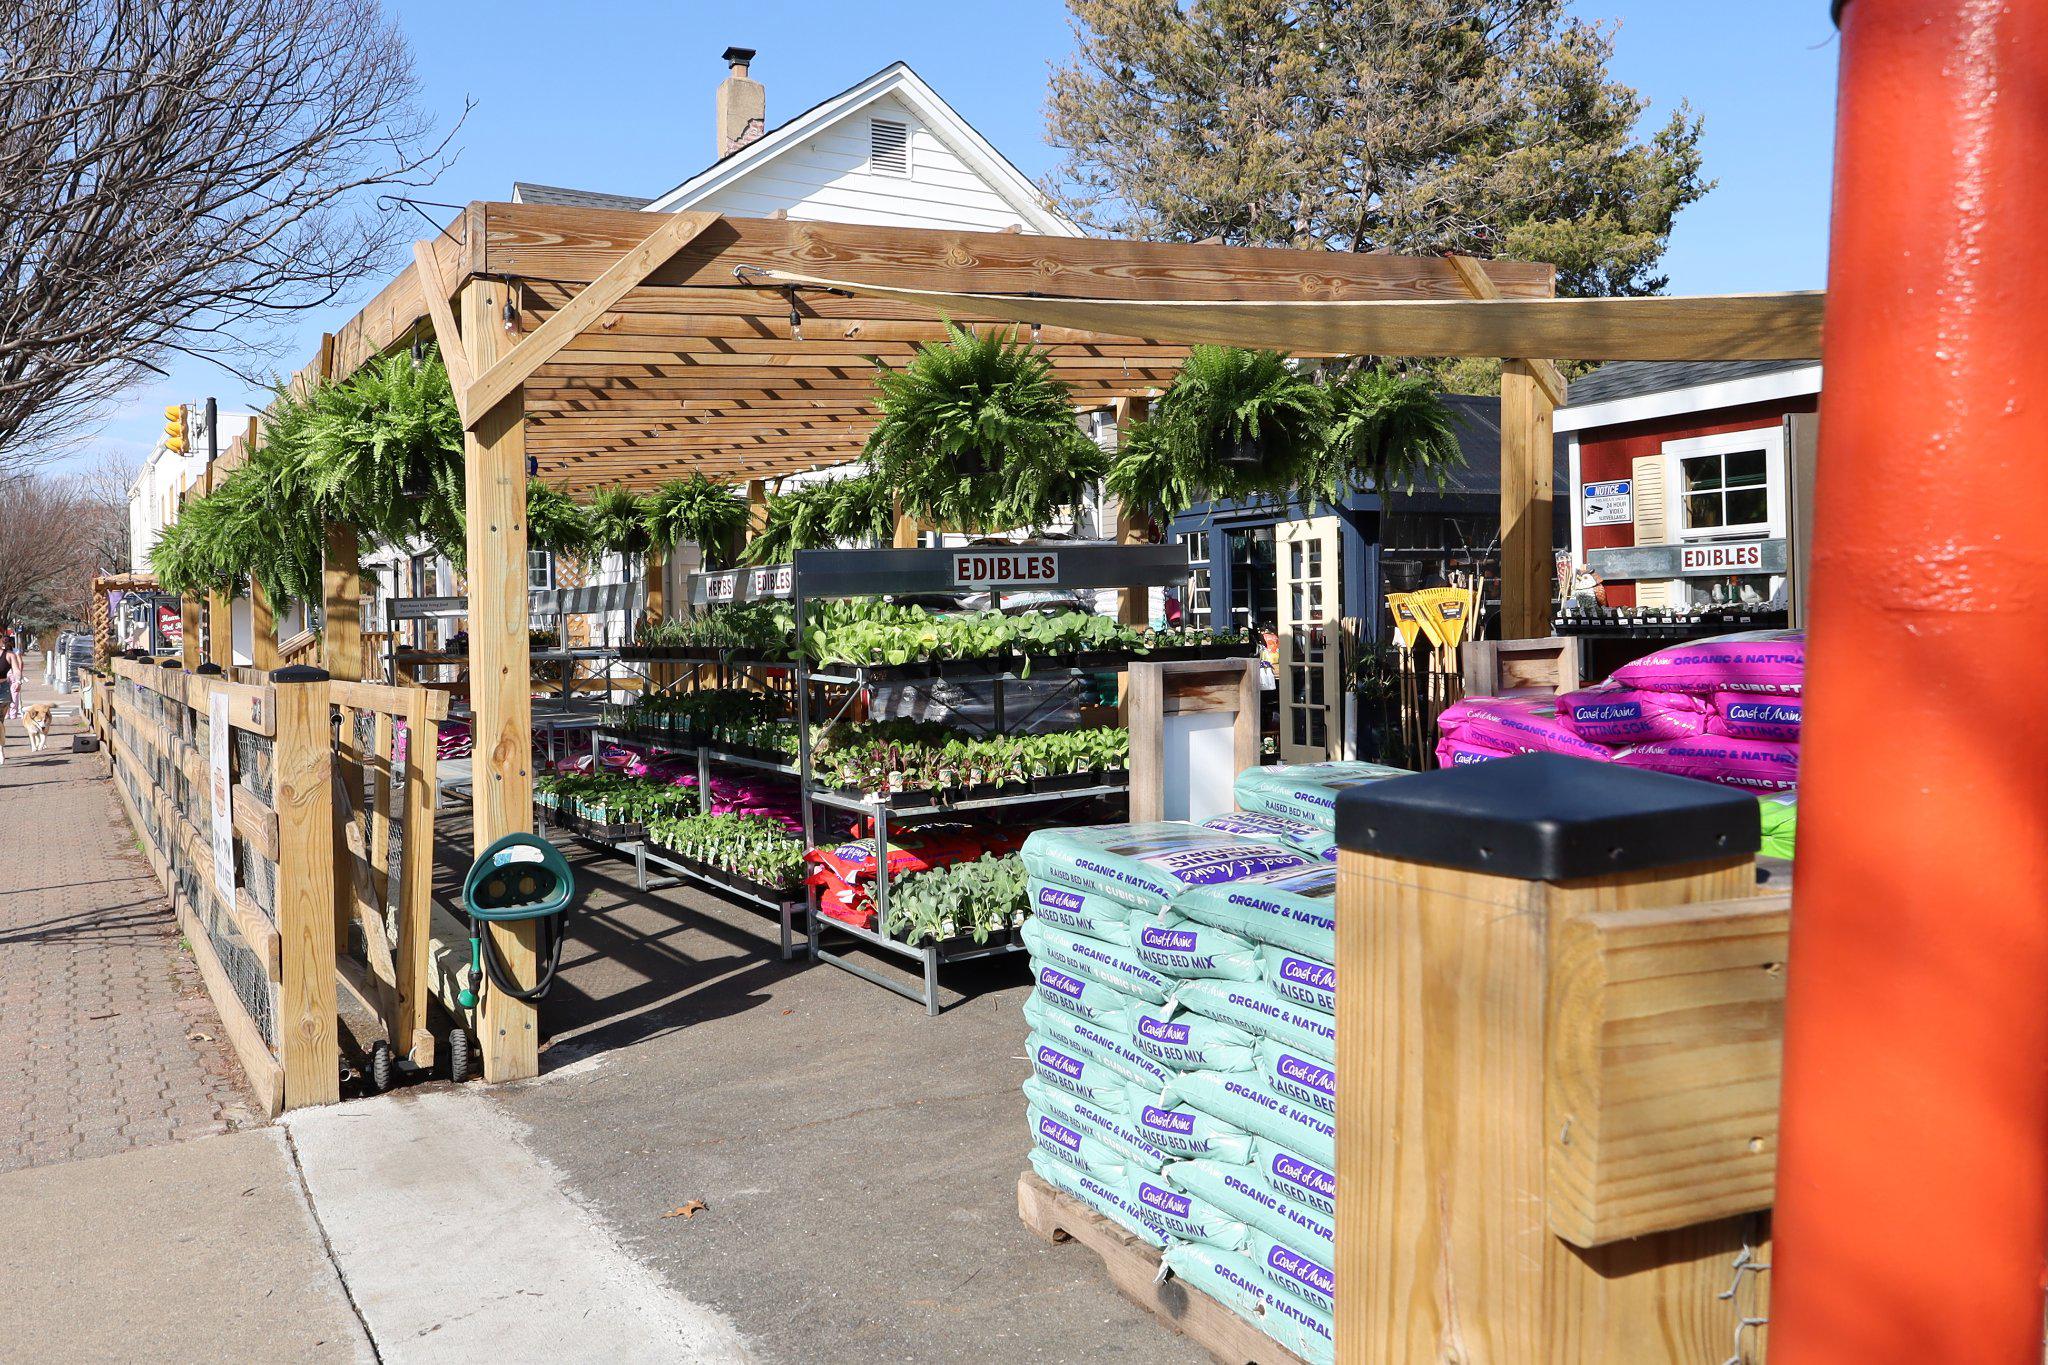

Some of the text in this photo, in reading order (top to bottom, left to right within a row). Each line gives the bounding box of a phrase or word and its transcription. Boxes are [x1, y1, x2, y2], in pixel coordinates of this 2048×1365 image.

[1596, 485, 1619, 496] NOTICE
[957, 556, 1056, 581] EDIBLES
[1684, 547, 1759, 568] EDIBLES
[708, 578, 732, 598] HERBS
[756, 570, 792, 592] EDIBLES
[1674, 654, 1732, 666] ORGANIC
[1733, 655, 1743, 664] &
[1729, 683, 1777, 692] CUBIC
[1779, 684, 1802, 693] FT
[1576, 706, 1635, 720] Coast of Maine
[1730, 705, 1772, 719] Coast of
[1501, 718, 1547, 737] ORGANIC
[1548, 732, 1556, 740] &
[1454, 752, 1471, 765] Coast
[1668, 747, 1726, 759] ORGANIC
[1729, 749, 1739, 759] &
[1726, 776, 1773, 788] CUBIC
[1776, 780, 1798, 790] FT
[1265, 800, 1288, 814] RAISED
[1288, 807, 1301, 817] BED
[1302, 811, 1316, 822] MIX
[1075, 857, 1116, 879] ORGANIC
[1116, 871, 1123, 882] &
[1168, 849, 1282, 868] ORGANIC
[1180, 855, 1308, 884] Coast of Maine
[1050, 867, 1070, 886] RAISED
[1070, 873, 1082, 888] BED
[1083, 877, 1096, 890] MIX
[1041, 890, 1058, 906] Coast
[1060, 895, 1080, 910] Maine
[1228, 893, 1281, 915] ORGANIC
[1281, 907, 1290, 918] &
[1060, 913, 1096, 931] BED MIX
[1047, 947, 1067, 964] RAISED
[1066, 954, 1079, 968] BED
[1079, 961, 1092, 975] MIX
[1071, 942, 1112, 966] ORGANIC
[1111, 957, 1119, 968] &
[1136, 946, 1216, 970] RAISED BED MIX
[1041, 970, 1058, 987] Coast
[1060, 979, 1080, 995] Maine
[1285, 961, 1324, 986] Coast of
[1060, 996, 1075, 1010] BED
[1076, 1003, 1094, 1018] MIX
[1228, 993, 1280, 1018] ORGANIC
[1281, 1011, 1290, 1023] &
[1068, 1037, 1081, 1050] BED
[1081, 1044, 1094, 1057] MIX
[1074, 1024, 1115, 1049] ORGANIC
[1114, 1041, 1122, 1053] &
[1122, 1045, 1167, 1080] NATURAL
[1164, 1046, 1207, 1064] BED MIX
[1039, 1048, 1057, 1065] Coast
[1060, 1059, 1080, 1076] Maine
[1281, 1059, 1320, 1086] Coast of
[1059, 1077, 1075, 1092] BED
[1076, 1086, 1095, 1100] MIX
[1224, 1081, 1278, 1111] ORGANIC
[1278, 1104, 1288, 1116] &
[1268, 1074, 1311, 1103] RAISED
[1069, 1114, 1081, 1128] BED
[1081, 1121, 1095, 1135] MIX
[1074, 1103, 1120, 1136] ORGANIC &
[1041, 1119, 1057, 1134] Coast
[1060, 1129, 1078, 1147] Maine
[1168, 1135, 1213, 1153] BED MIX
[1058, 1146, 1073, 1163] BED
[1074, 1156, 1092, 1172] MIX
[1277, 1158, 1304, 1181] Coast
[1301, 1169, 1315, 1186] of
[1079, 1177, 1127, 1211] ORGANIC &
[1224, 1175, 1287, 1216] ORGANIC &
[1308, 1194, 1334, 1215] BED
[1165, 1216, 1209, 1239] BED MIX
[1272, 1250, 1298, 1274] Coast
[1297, 1263, 1310, 1281] of
[1214, 1264, 1333, 1341] ORGANIC & NATURAL
[1303, 1288, 1328, 1311] BED
